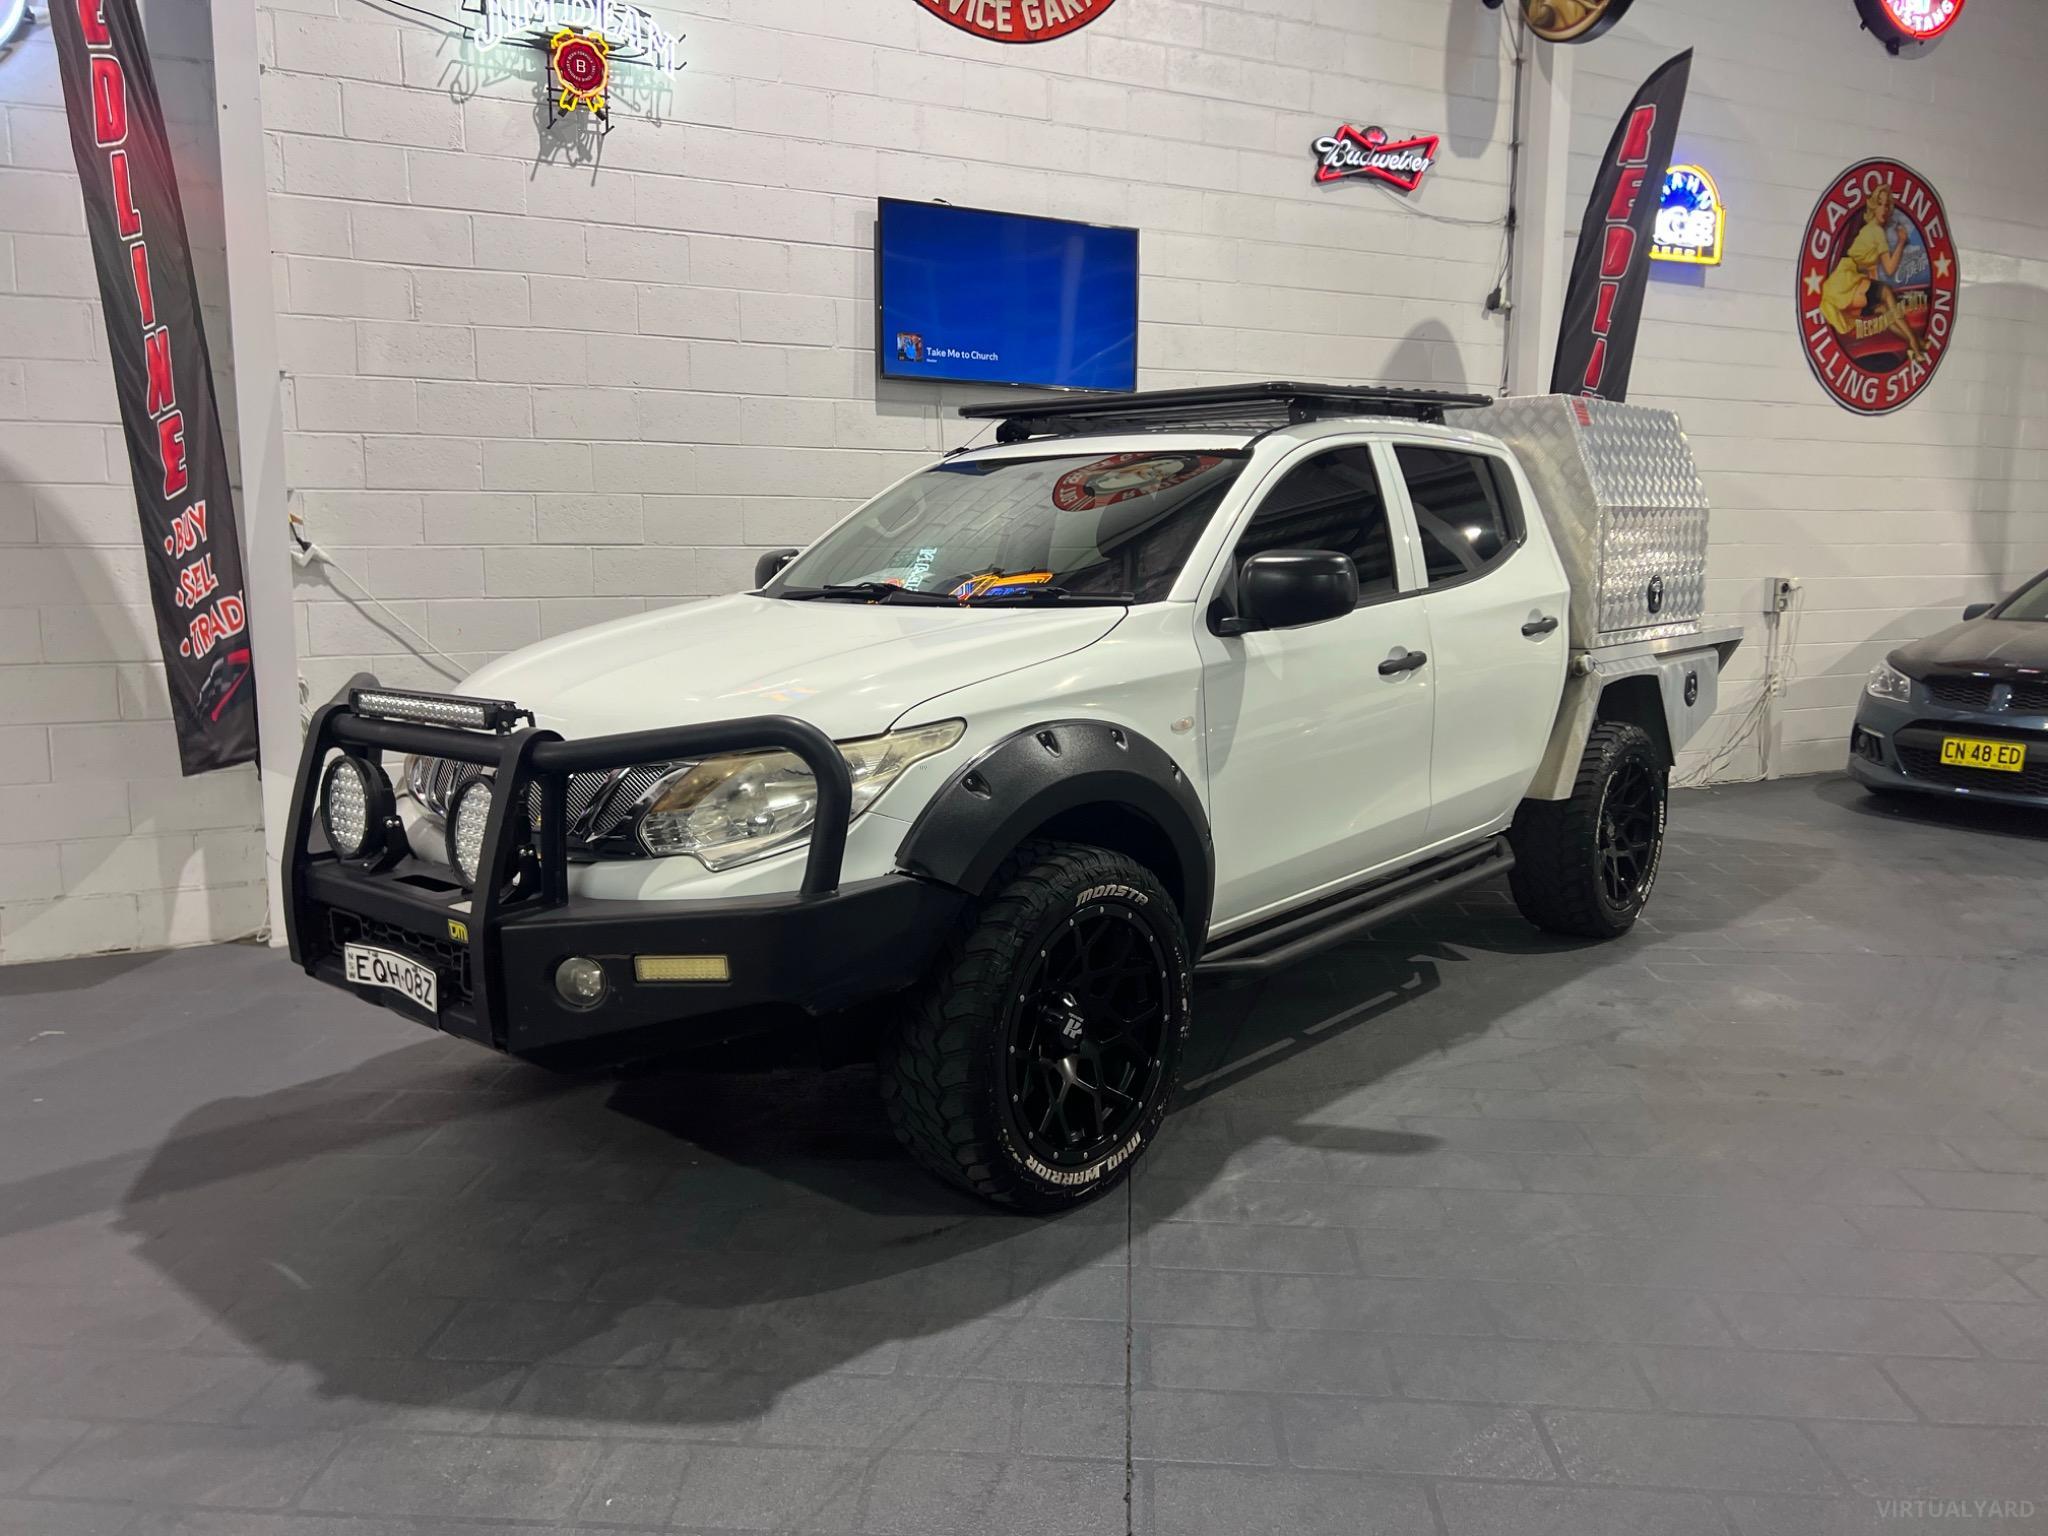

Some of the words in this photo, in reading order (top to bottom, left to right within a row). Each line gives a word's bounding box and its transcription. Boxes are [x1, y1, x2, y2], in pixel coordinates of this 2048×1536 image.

[1021, 0, 1092, 31] GAR
[1886, 0, 1955, 32] USTANG
[576, 59, 586, 73] B
[1316, 136, 1434, 173] Budweiser
[1809, 170, 1944, 261] GASOLINE
[1581, 103, 1657, 401] REDLI
[926, 346, 946, 358] Take
[947, 348, 960, 359] Me
[961, 350, 970, 359] to
[971, 350, 999, 361] Church
[1805, 308, 1879, 405] FILLING
[172, 500, 207, 558] BUY
[180, 553, 219, 609] SELL
[190, 591, 245, 660] TRAD
[1075, 883, 1149, 908] MONSTA
[1025, 1153, 1102, 1186] WARRIOR
[1107, 1131, 1142, 1172] MUD
